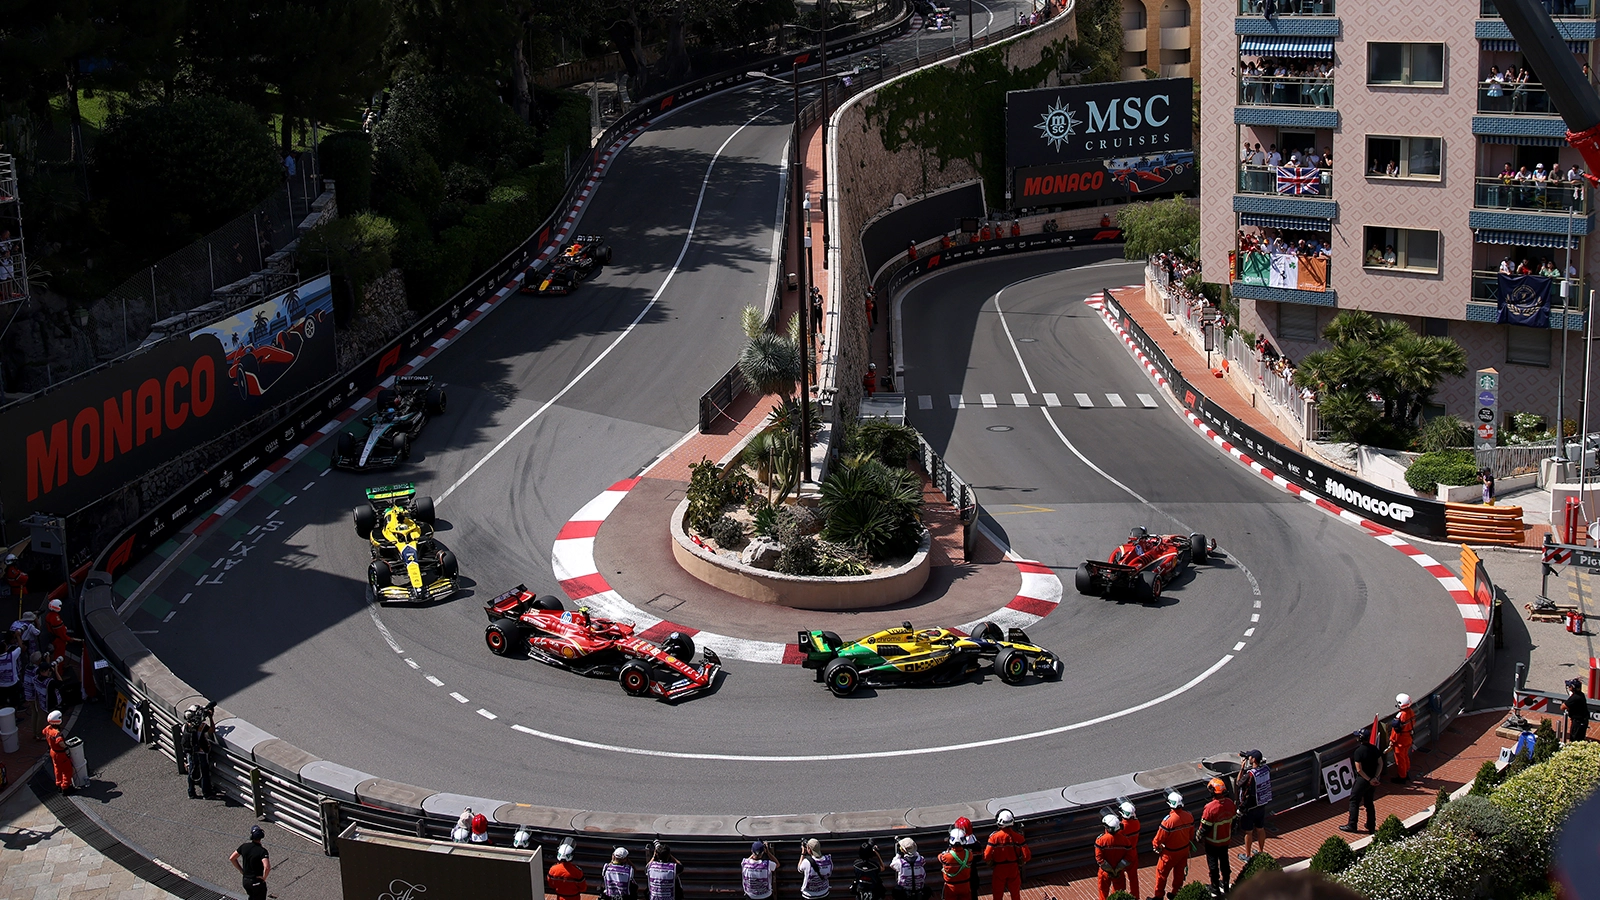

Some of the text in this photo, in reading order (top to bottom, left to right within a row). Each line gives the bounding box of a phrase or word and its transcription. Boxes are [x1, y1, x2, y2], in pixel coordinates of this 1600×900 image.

[1085, 94, 1170, 134] MSC
[1085, 133, 1170, 150] CRUISES
[1023, 170, 1105, 197] MONACO
[25, 354, 216, 503] MONACO
[193, 487, 213, 504] aramco
[1325, 477, 1414, 523] #MonacoGP
[149, 522, 165, 537] ROLEX
[205, 520, 285, 585] TAXIS
[125, 706, 141, 735] SC
[1328, 765, 1353, 796] SC
